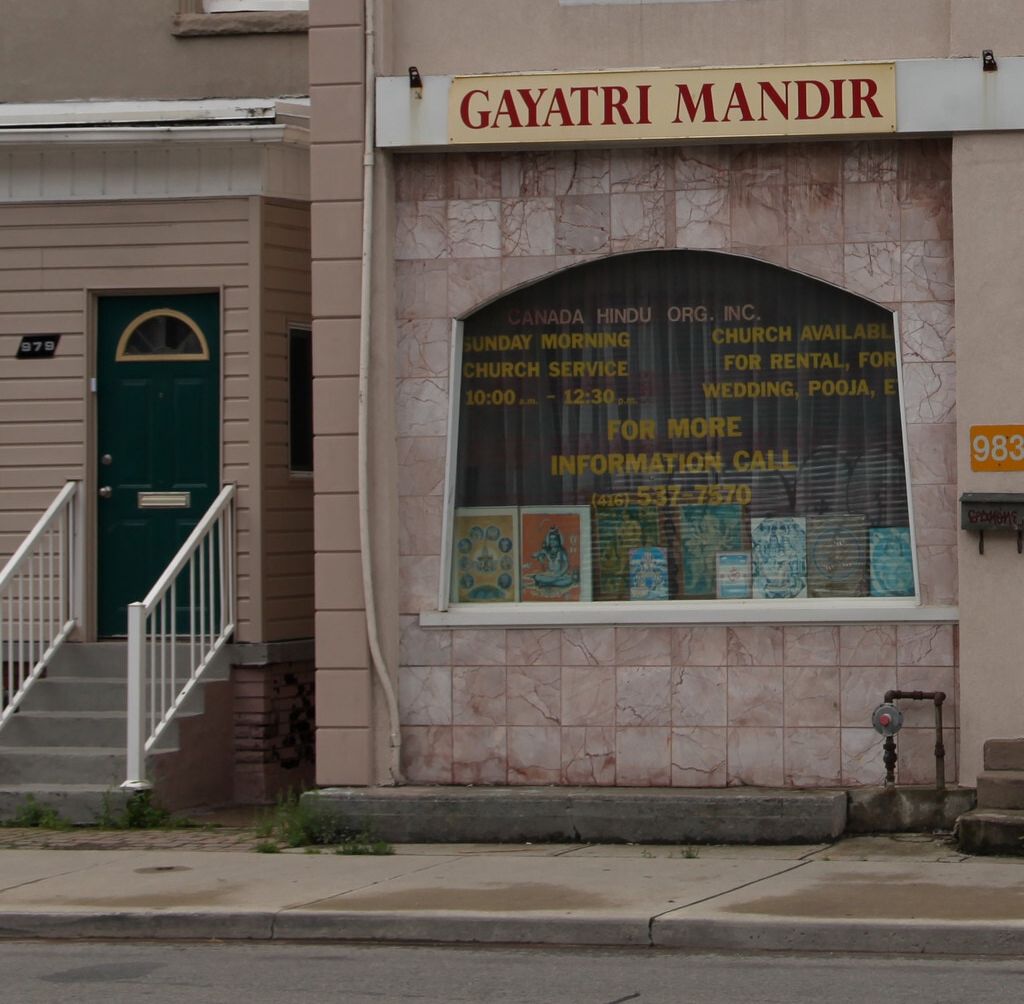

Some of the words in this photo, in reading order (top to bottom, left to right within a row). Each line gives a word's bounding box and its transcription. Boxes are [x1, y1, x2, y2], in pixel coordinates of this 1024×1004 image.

[460, 83, 653, 130] GAYATRI
[671, 77, 884, 124] MANDIR
[508, 308, 585, 325] CANADA
[597, 307, 652, 324] HINDU
[667, 305, 715, 323] ORG.
[723, 303, 761, 321] INC.
[541, 331, 631, 350] MORNING
[712, 325, 793, 345] CHURCH
[800, 323, 895, 341] AVAILABL
[21, 340, 55, 352] 979
[463, 361, 541, 379] CHURCH
[548, 361, 630, 378] SERVICE
[723, 353, 763, 371] FOR
[770, 352, 850, 372] RENTAL,
[858, 351, 897, 369] FOR
[465, 389, 516, 405] 10:00
[518, 397, 539, 405] a.m.
[563, 388, 616, 405] 12:30
[702, 381, 800, 400] WEDDING,
[808, 379, 876, 399] POOJA,
[607, 419, 656, 441] FOR
[667, 416, 743, 439] MORE
[551, 450, 722, 476] INFORMATION
[732, 449, 799, 472] CALL
[591, 492, 631, 508] (416)
[636, 484, 752, 507] 537-7570
